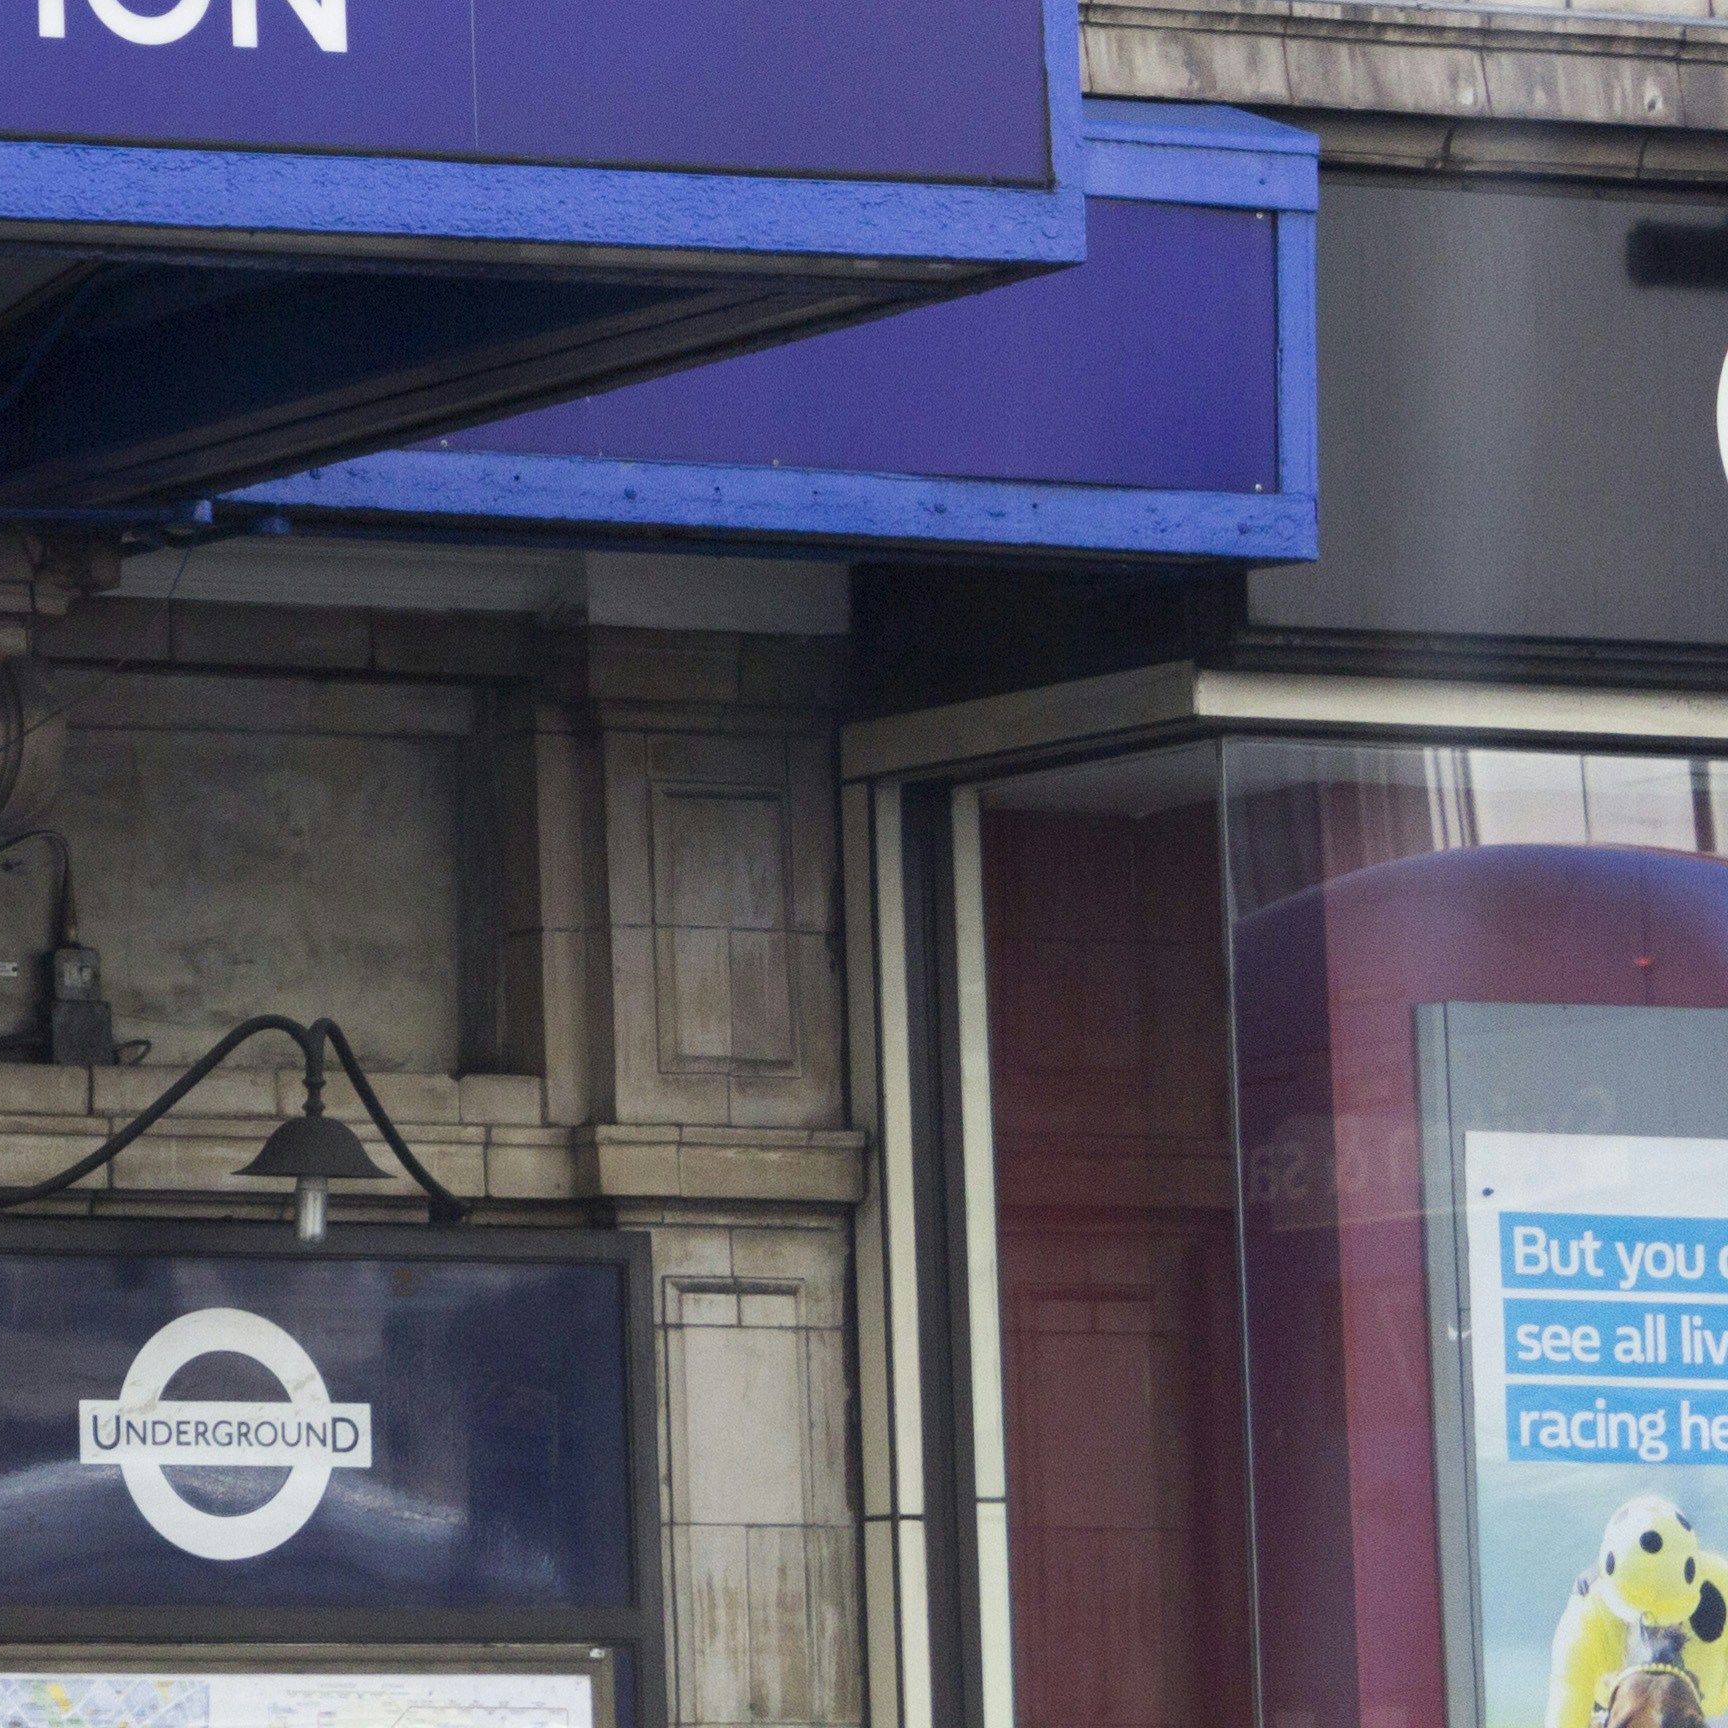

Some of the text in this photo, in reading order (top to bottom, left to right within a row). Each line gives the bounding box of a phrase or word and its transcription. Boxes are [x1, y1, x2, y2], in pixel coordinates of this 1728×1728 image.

[1513, 1225, 1604, 1277] But
[1615, 1241, 1706, 1290] you
[1516, 1323, 1601, 1363] see
[1614, 1313, 1667, 1364] all
[92, 1414, 360, 1453] UNDERGROUND
[1519, 1397, 1670, 1462] racing
